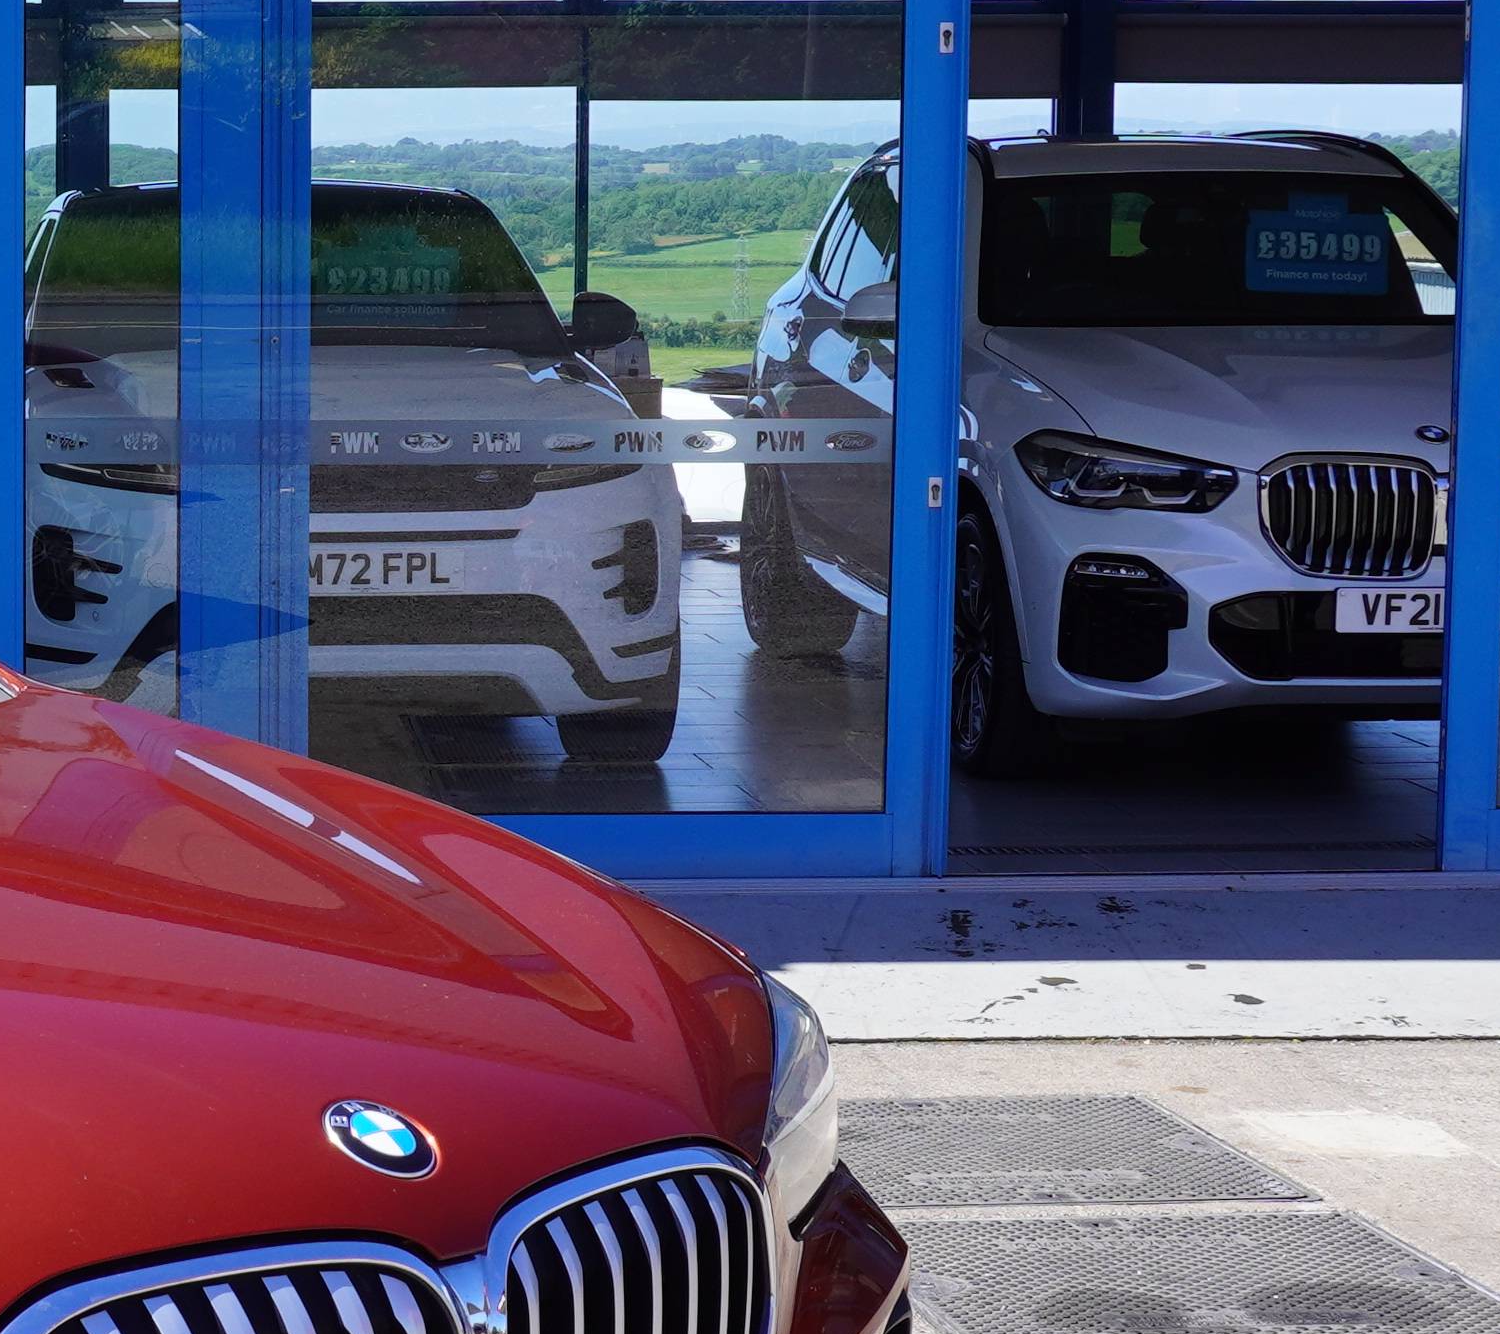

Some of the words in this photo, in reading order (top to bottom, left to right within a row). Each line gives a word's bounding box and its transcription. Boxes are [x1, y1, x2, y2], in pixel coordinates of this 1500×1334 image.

[1256, 230, 1382, 263] £35499
[1265, 268, 1310, 280] Finance
[1312, 271, 1329, 281] me
[330, 431, 380, 454] PWM
[472, 431, 522, 454] PWM
[614, 431, 664, 453] PWM
[756, 430, 806, 453] PWM
[308, 552, 371, 585] M72
[382, 552, 450, 585] FPL
[1362, 593, 1441, 626] VF21
